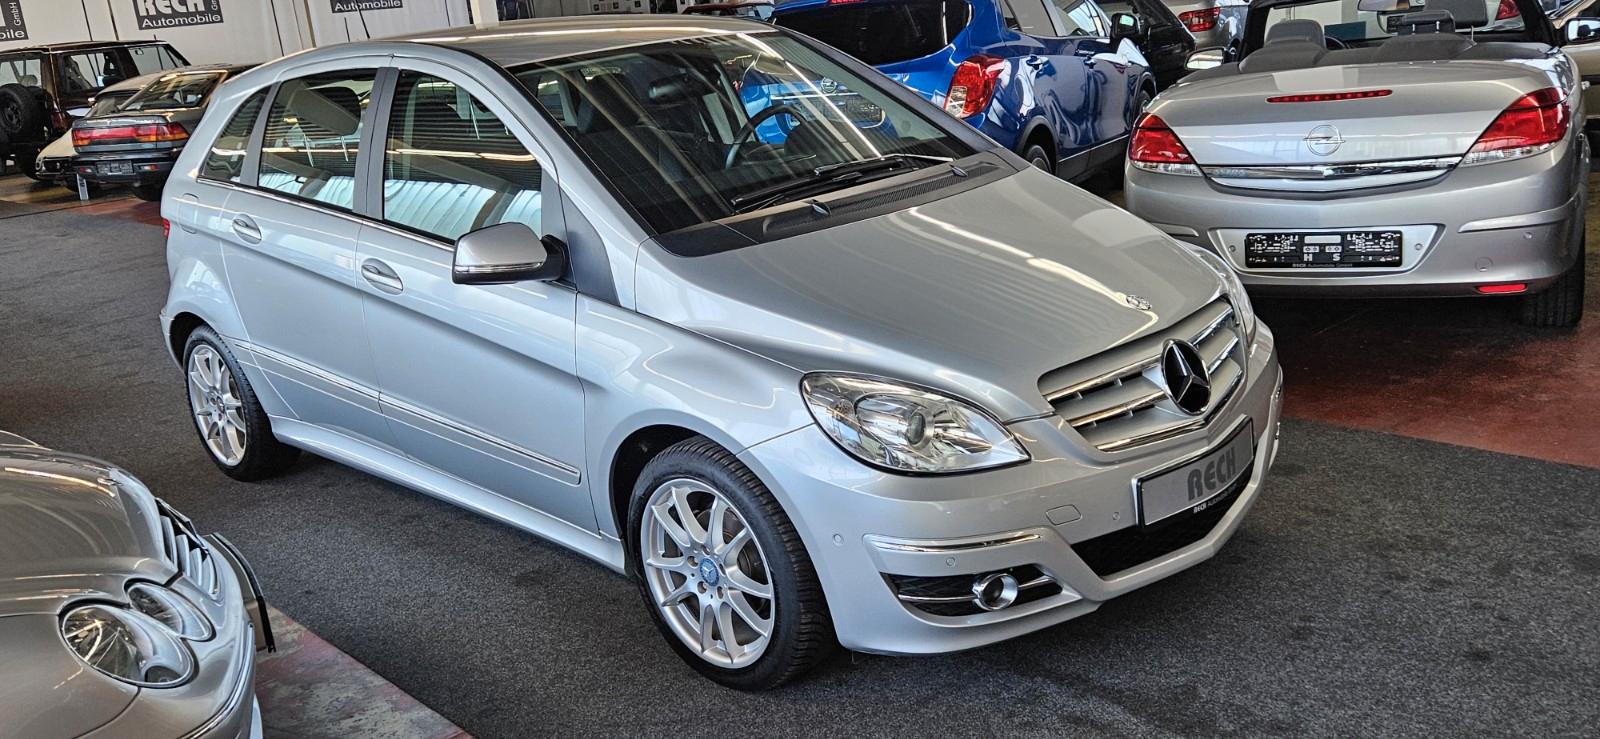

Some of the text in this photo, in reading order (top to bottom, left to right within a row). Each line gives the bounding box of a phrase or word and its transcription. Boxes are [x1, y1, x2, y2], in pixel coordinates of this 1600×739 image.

[334, 0, 402, 12] Automobile
[142, 13, 221, 28] Automobile
[1187, 447, 1236, 502] RECH
[1193, 502, 1207, 514] RECH
